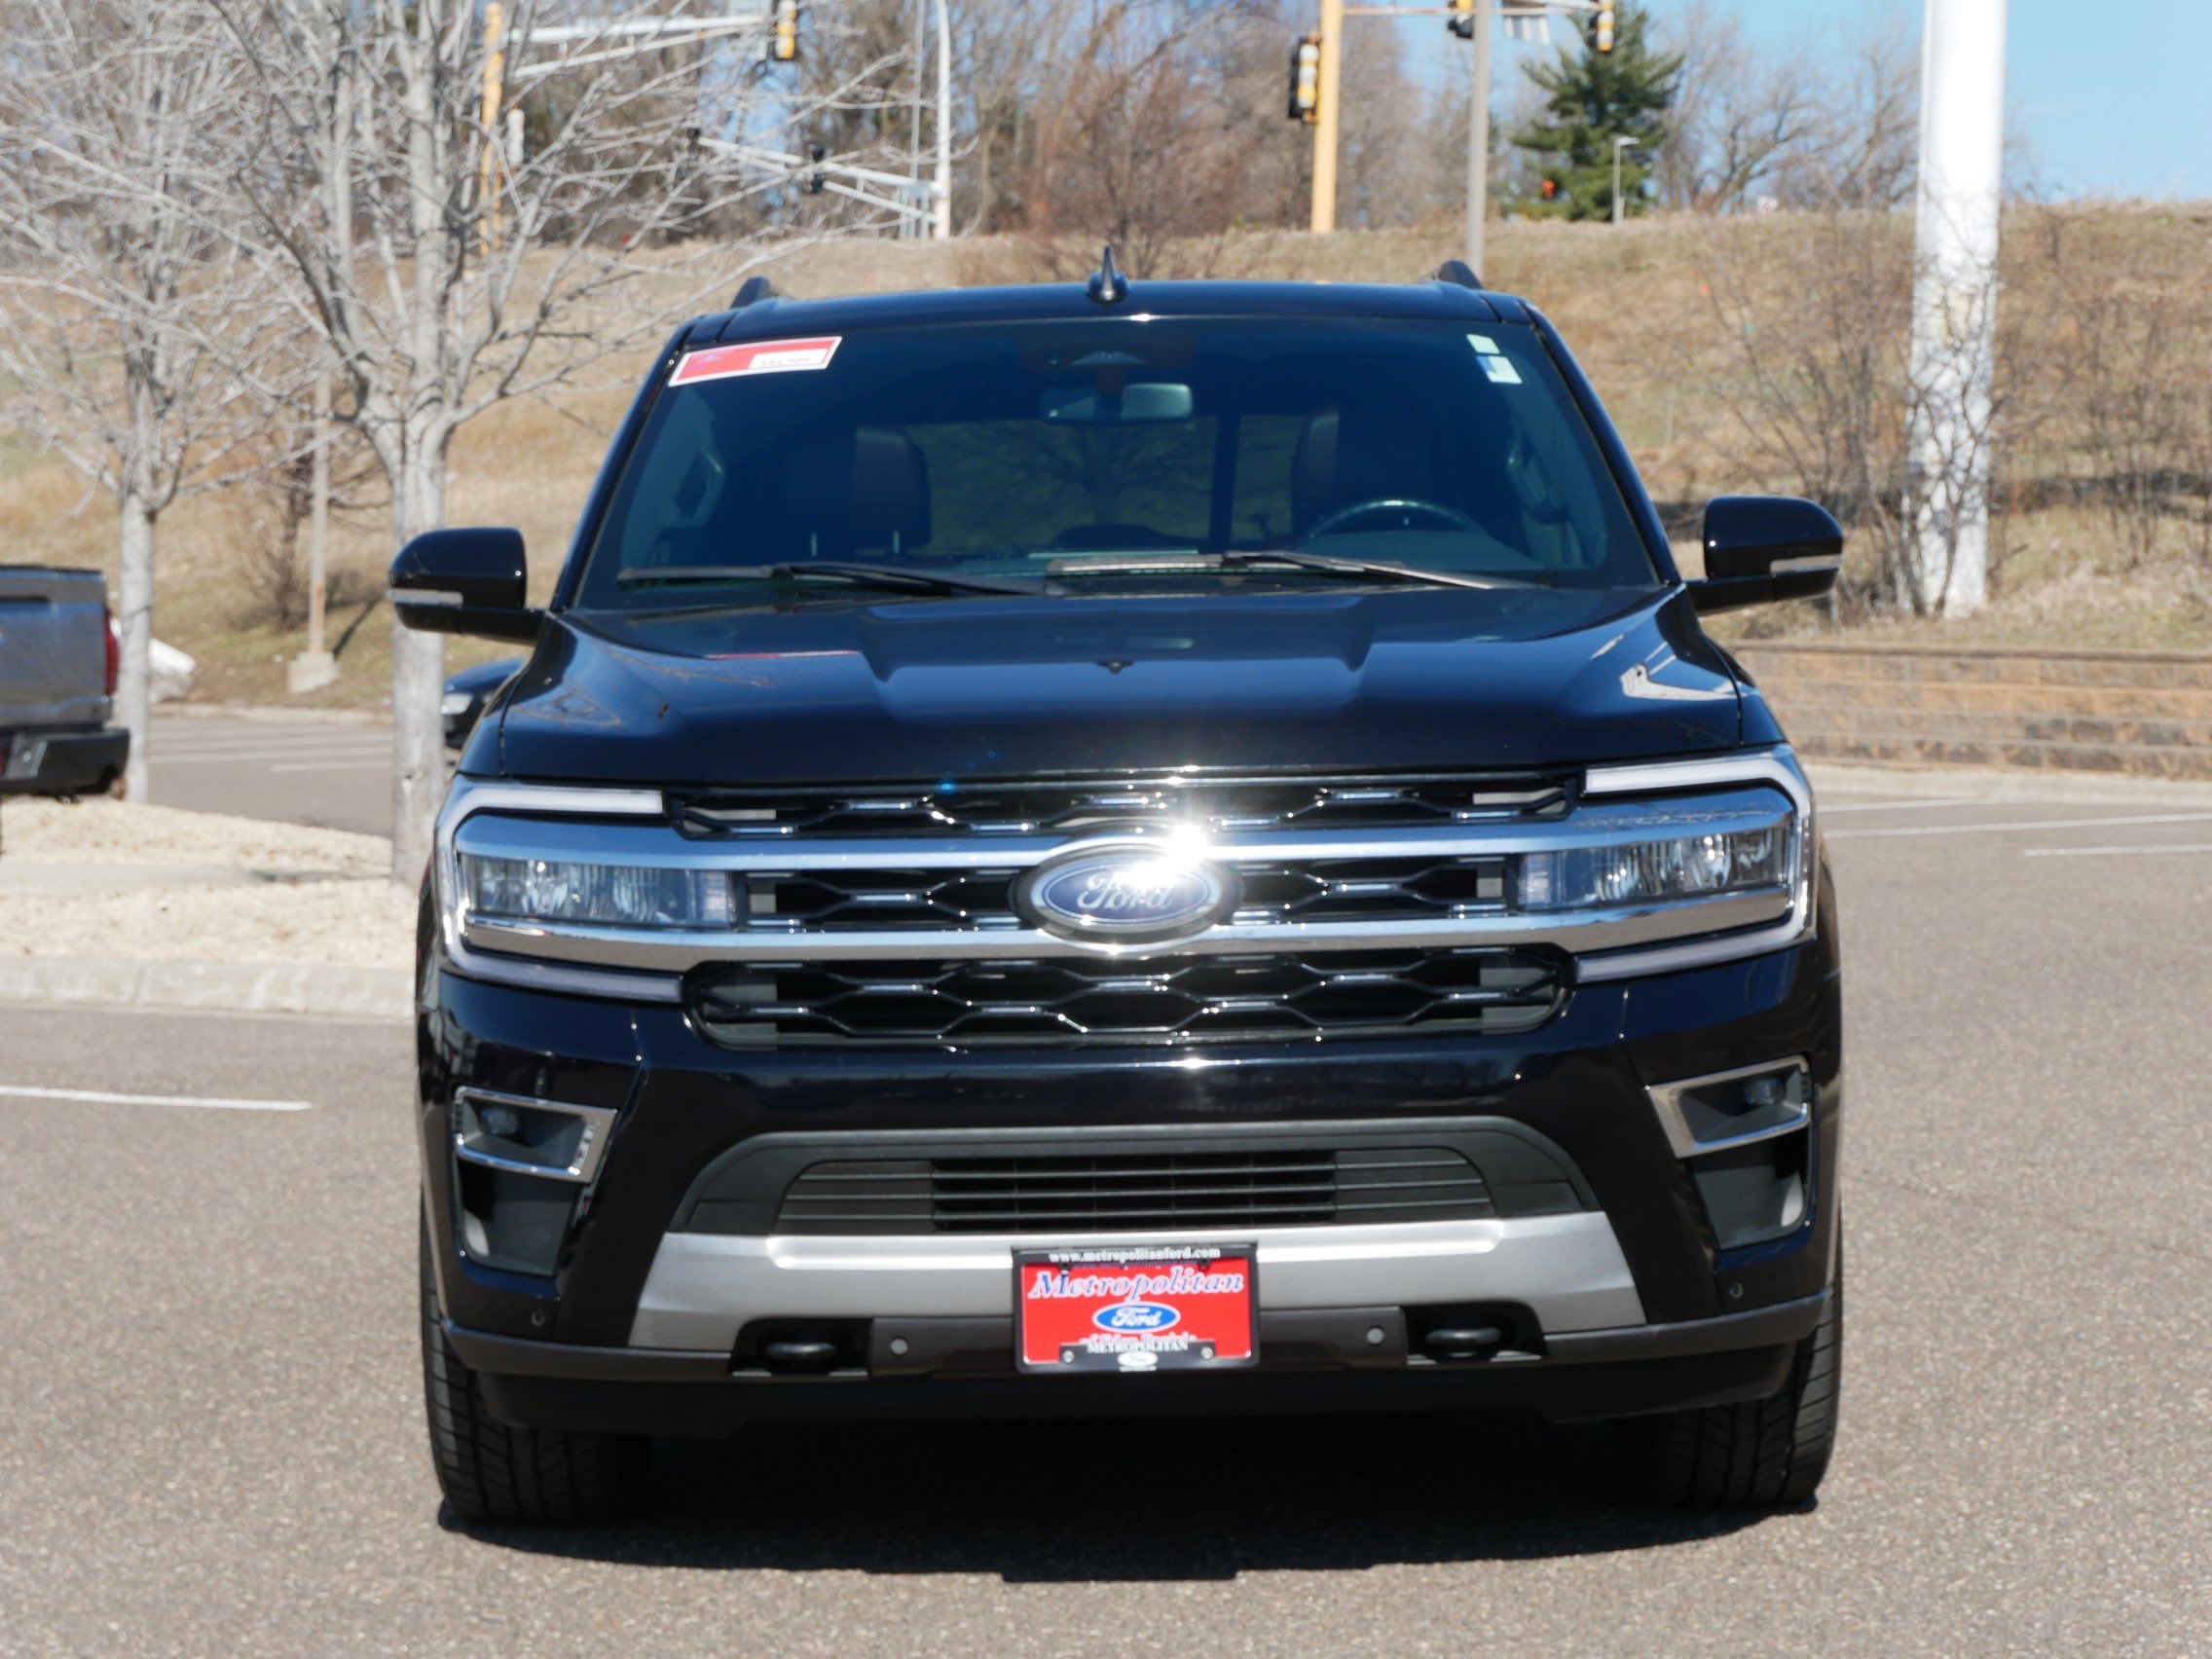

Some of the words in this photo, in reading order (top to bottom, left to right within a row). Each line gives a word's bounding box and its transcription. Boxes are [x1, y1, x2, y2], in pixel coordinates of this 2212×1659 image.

[1077, 872, 1176, 909] Ford
[1049, 1247, 1221, 1263] www.metropolitanford.com
[1027, 1266, 1245, 1302] Metropolitan
[1111, 1306, 1161, 1327] Ford
